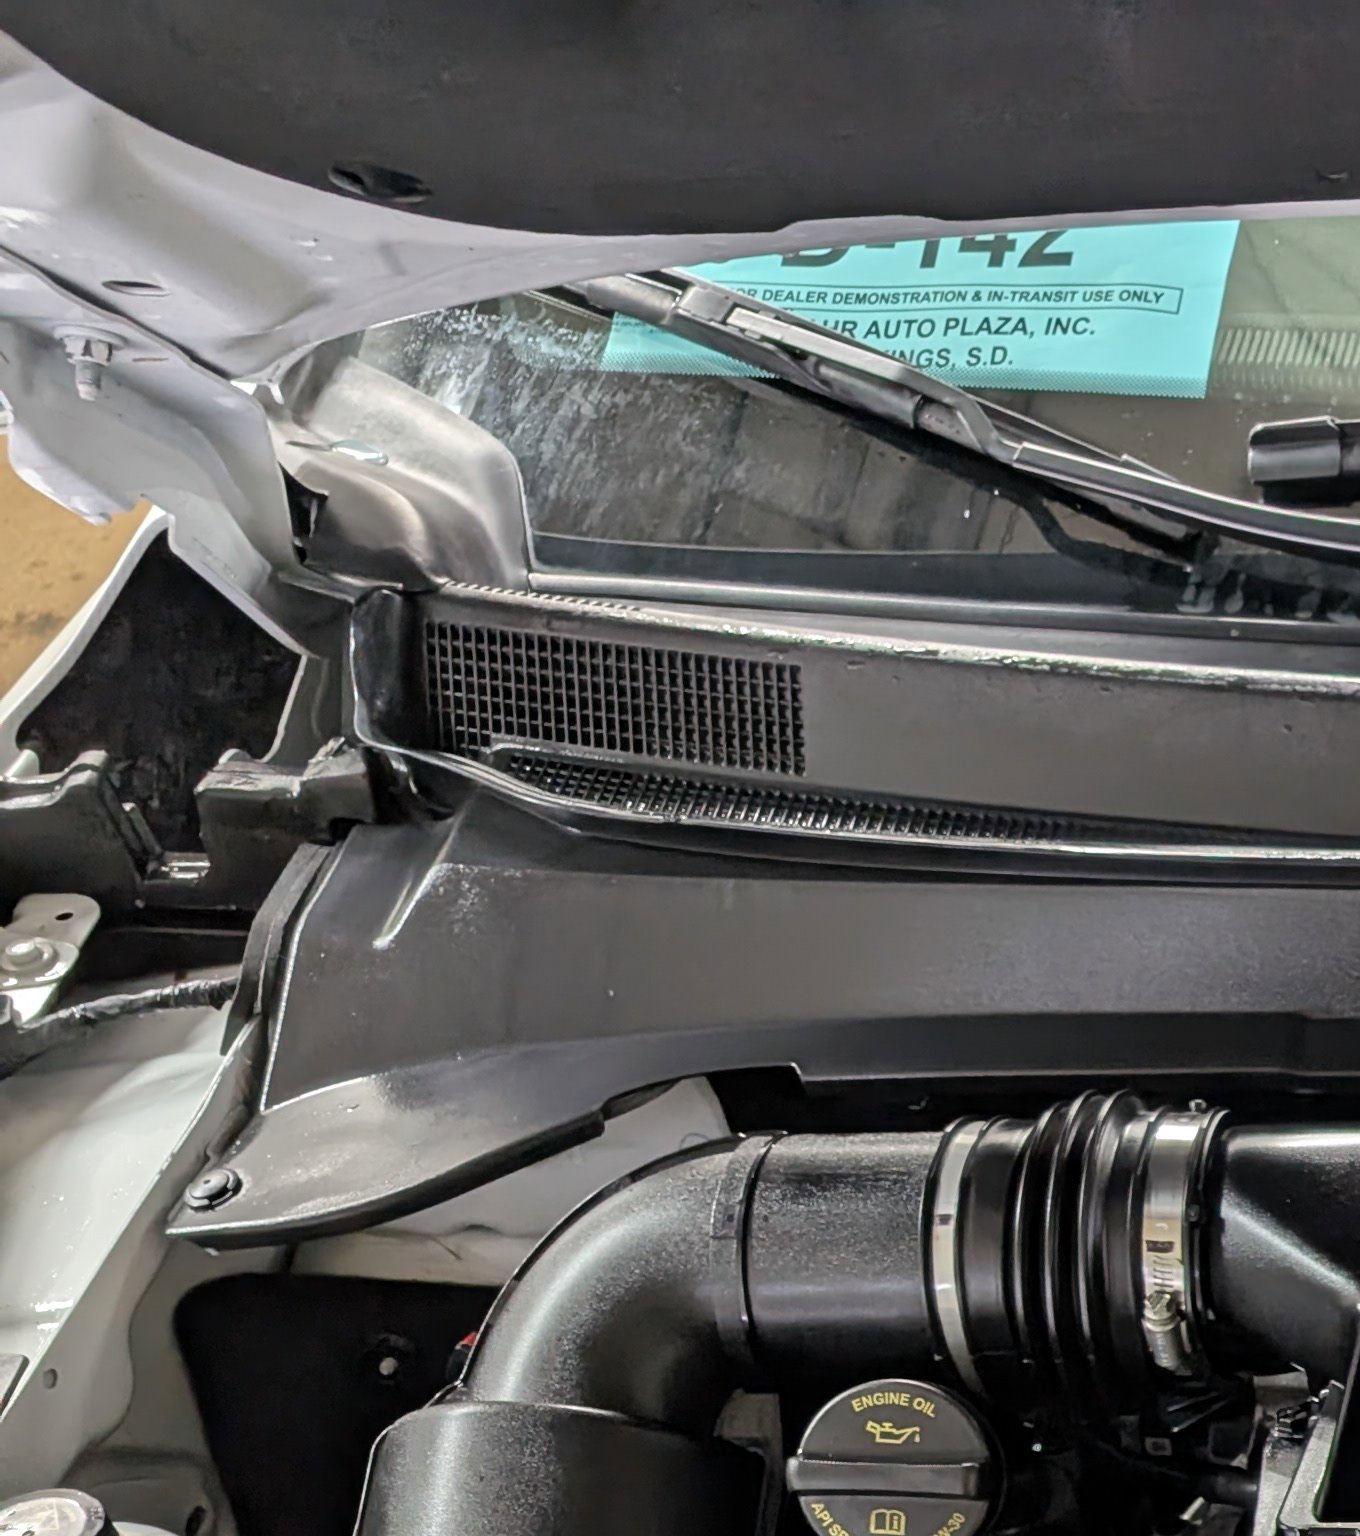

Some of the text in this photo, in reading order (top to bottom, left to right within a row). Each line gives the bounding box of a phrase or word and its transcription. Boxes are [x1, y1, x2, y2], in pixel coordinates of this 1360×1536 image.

[761, 289, 828, 304] DEALER
[832, 290, 968, 305] DEMONSTRATION
[971, 290, 982, 301] &
[987, 290, 1079, 302] IN-TRANSIT
[1082, 289, 1115, 302] USE
[1118, 289, 1165, 304] ONLY
[862, 318, 937, 339] AUTO
[942, 317, 1036, 339] PLAZA,
[1043, 316, 1096, 336] INC.
[965, 346, 1015, 367] S.D.
[851, 1391, 937, 1418] ENGINE OIL
[811, 1503, 832, 1530] API
